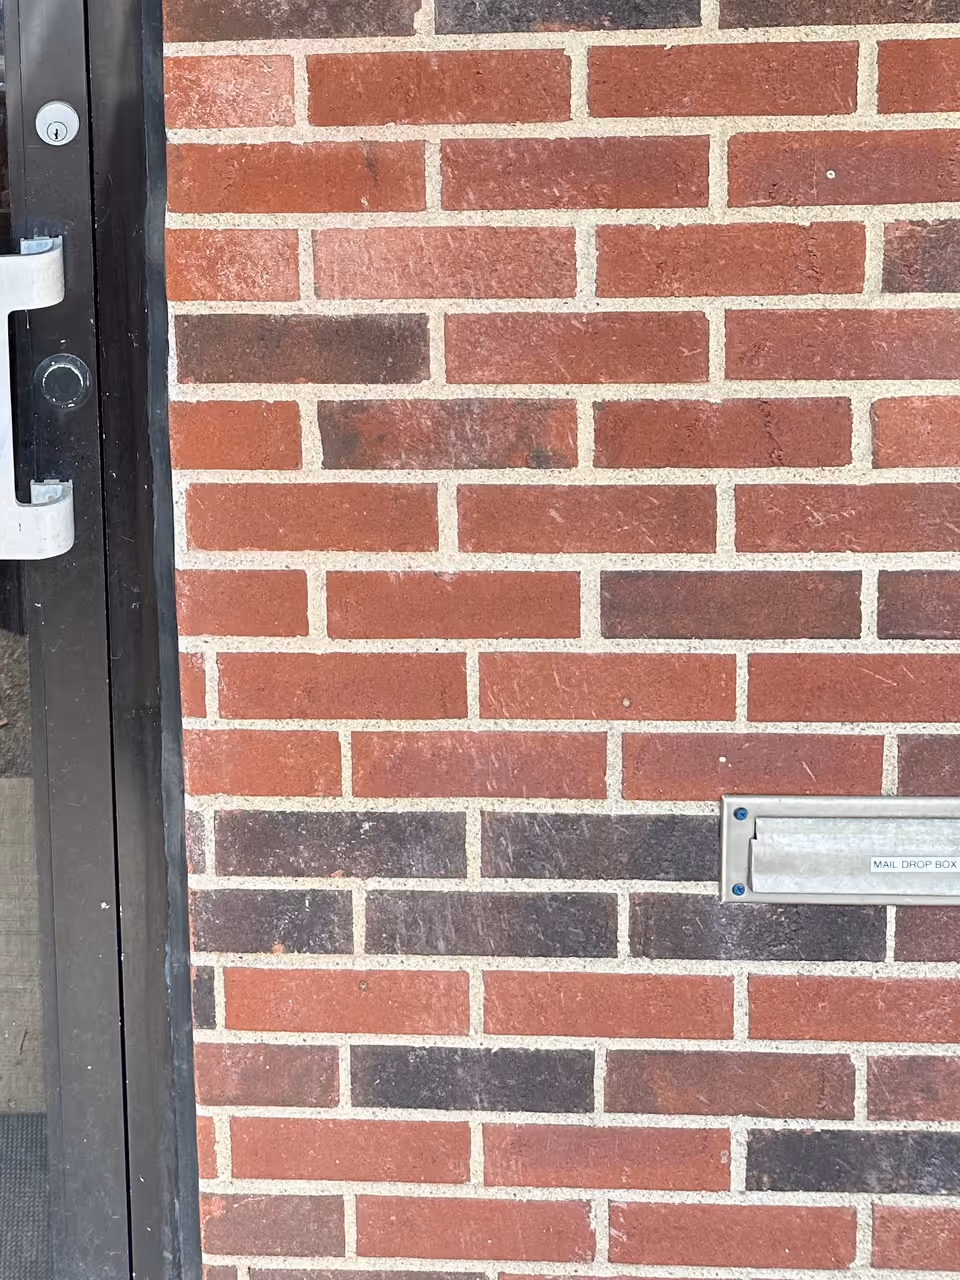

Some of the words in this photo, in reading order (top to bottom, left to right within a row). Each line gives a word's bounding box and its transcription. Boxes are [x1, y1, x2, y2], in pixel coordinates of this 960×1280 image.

[872, 860, 898, 869] MAIL
[901, 860, 933, 869] DROP
[935, 860, 958, 869] BOX
